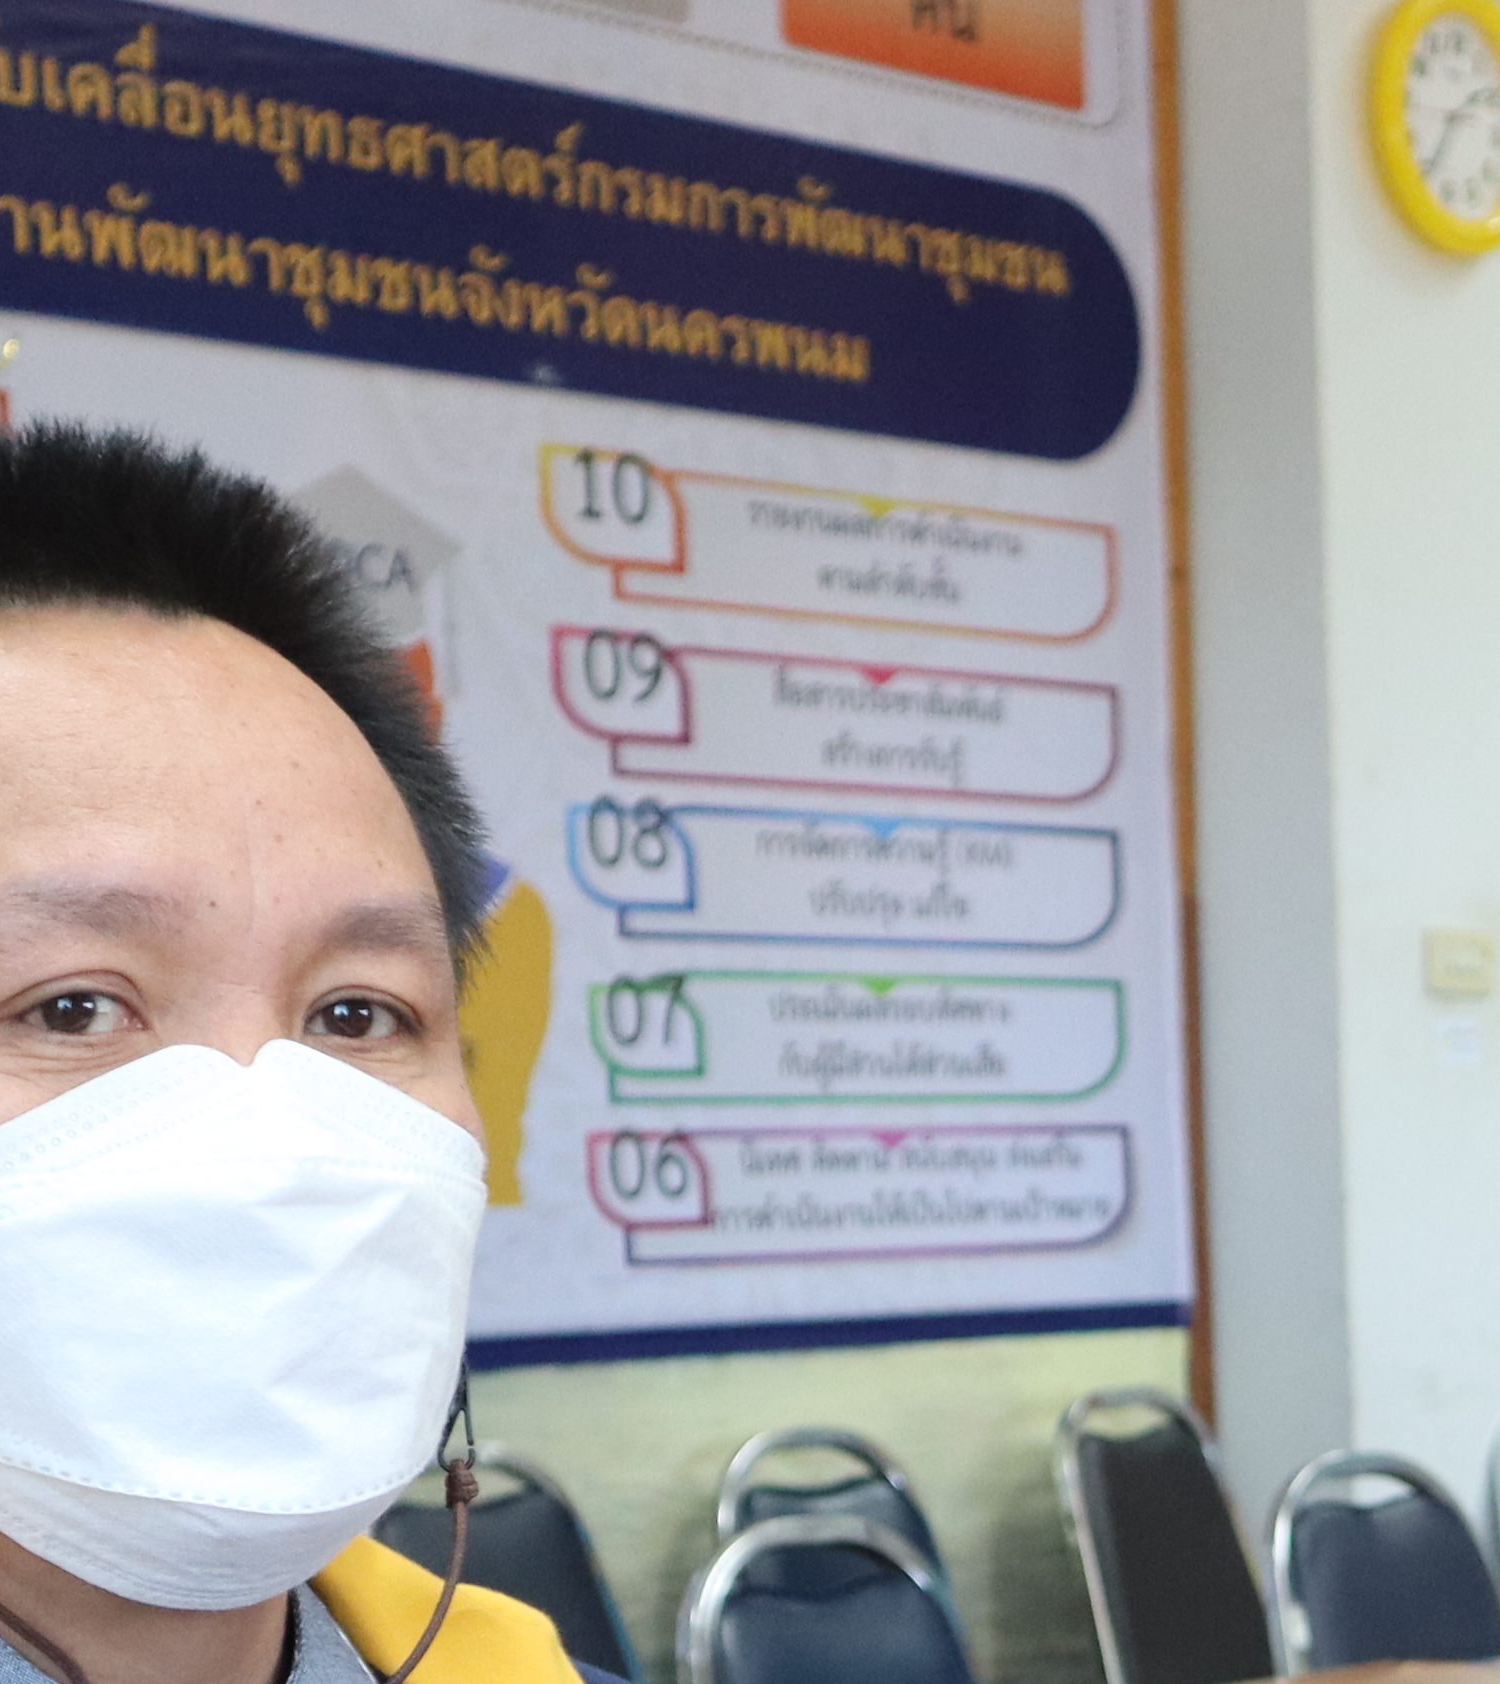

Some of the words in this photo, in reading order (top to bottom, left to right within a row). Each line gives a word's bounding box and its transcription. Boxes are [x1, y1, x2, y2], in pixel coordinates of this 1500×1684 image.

[574, 450, 654, 526] 10
[584, 628, 668, 704] 09
[586, 800, 670, 869] 08
[606, 975, 687, 1047] 07
[610, 1129, 690, 1199] 06
